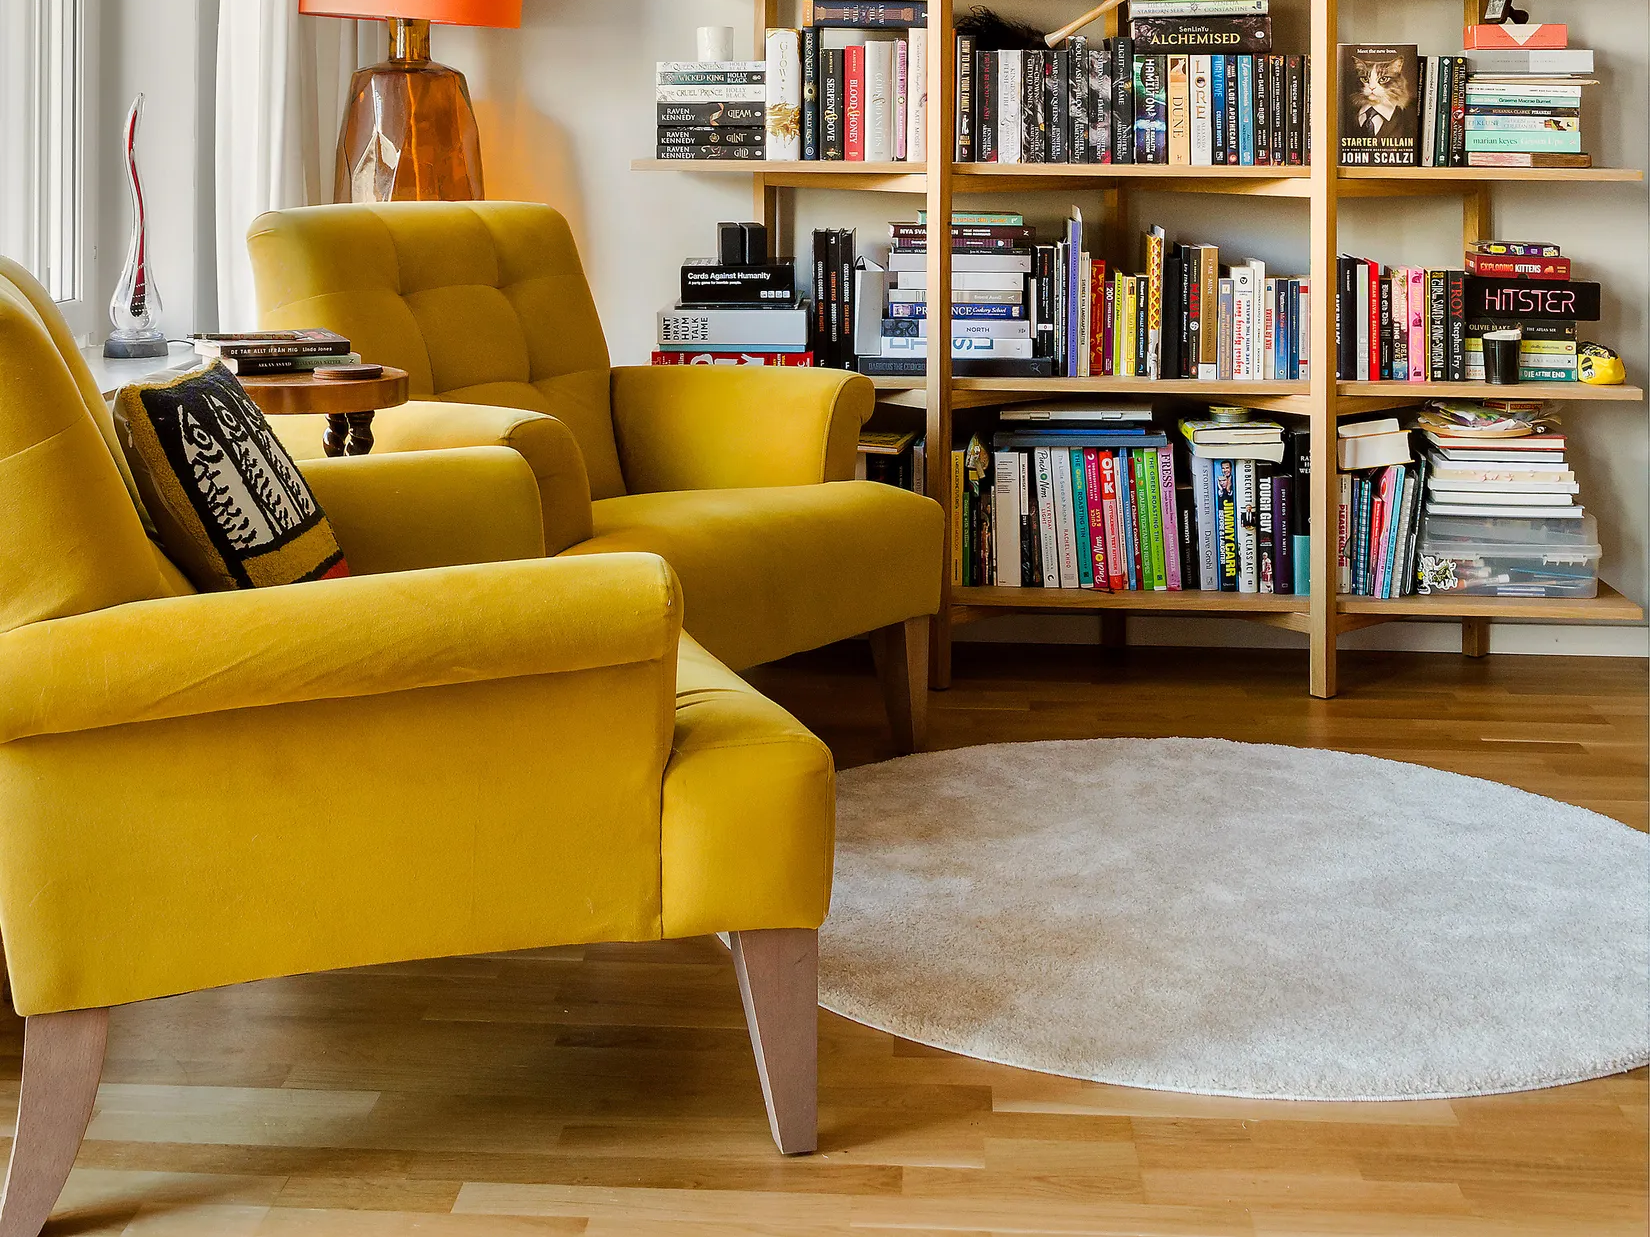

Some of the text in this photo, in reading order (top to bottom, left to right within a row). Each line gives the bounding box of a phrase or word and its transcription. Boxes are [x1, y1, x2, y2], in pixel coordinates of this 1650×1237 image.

[961, 40, 970, 54] HOW
[1151, 33, 1241, 45] ALCHEMISED
[961, 62, 970, 75] KILL
[1214, 61, 1222, 97] UGLY LOVE
[827, 78, 835, 113] SERPENT
[850, 79, 858, 108] BLOOD
[961, 77, 970, 92] YOUR
[1145, 59, 1155, 113] HAMILTON
[1195, 60, 1207, 119] LORE
[728, 109, 752, 119] GLEAM
[961, 93, 970, 113] FAMILY
[827, 117, 835, 141] DOVE
[849, 114, 858, 143] HONEY
[1172, 96, 1184, 138] DUNE
[726, 133, 747, 143] GLINT
[1341, 138, 1414, 147] STARTER VILLAIN
[1499, 137, 1518, 145] keyes
[1341, 153, 1414, 163] JOHN SCALZI
[687, 272, 771, 281] Cards Against Humanity
[1480, 262, 1541, 273] EXPLODING KITTENS
[1106, 287, 1114, 300] 200
[1190, 283, 1199, 318] MAUS
[1485, 288, 1575, 313] HITSTER
[663, 318, 671, 341] HINT
[681, 318, 690, 341] HUM
[700, 318, 708, 341] MIME
[1432, 279, 1444, 368] GIRL SAVED KING SWEDEN
[1451, 278, 1463, 368] TROY Stephen Fry
[1234, 300, 1245, 375] Magical Mystery Tours
[1038, 451, 1050, 500] Pinch Nom
[1161, 453, 1173, 488] FRESS
[1077, 491, 1085, 525] ROASTING
[1151, 496, 1159, 529] ROASTING
[1259, 477, 1271, 533] TOUGH GUY
[1223, 500, 1236, 577] JIMMY CARR
[1205, 550, 1213, 570] Grohl
[1339, 555, 1345, 567] ME
